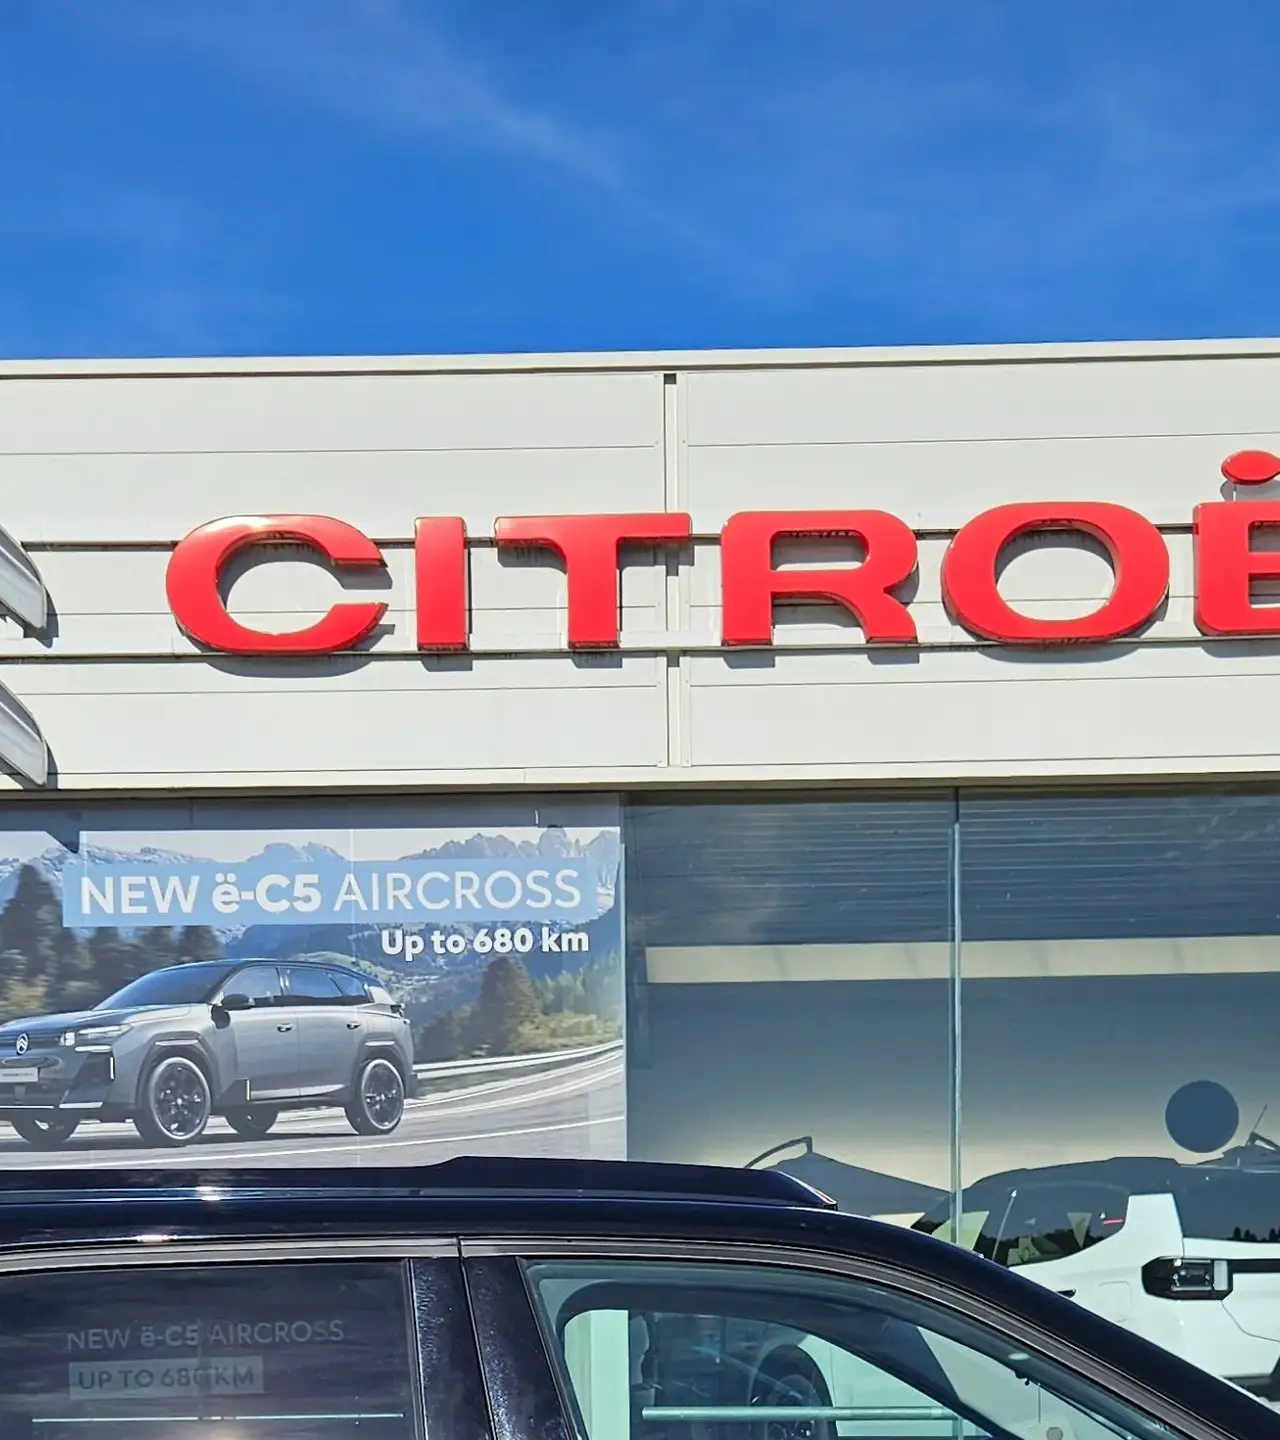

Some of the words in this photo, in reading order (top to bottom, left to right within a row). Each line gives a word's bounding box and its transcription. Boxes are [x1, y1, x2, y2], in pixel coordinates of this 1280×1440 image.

[80, 872, 196, 916] NEW
[211, 870, 321, 914] ë-C5
[333, 866, 583, 912] AIRCROSS
[380, 929, 423, 960] Up
[431, 930, 465, 955] to
[473, 928, 533, 955] 680
[542, 926, 590, 953] km
[67, 1328, 130, 1350] NEW
[140, 1324, 199, 1347] ë-C5
[207, 1319, 345, 1346] AIRCROSS
[79, 1372, 111, 1390] UP
[118, 1369, 154, 1389] TO
[214, 1364, 255, 1386] KM
